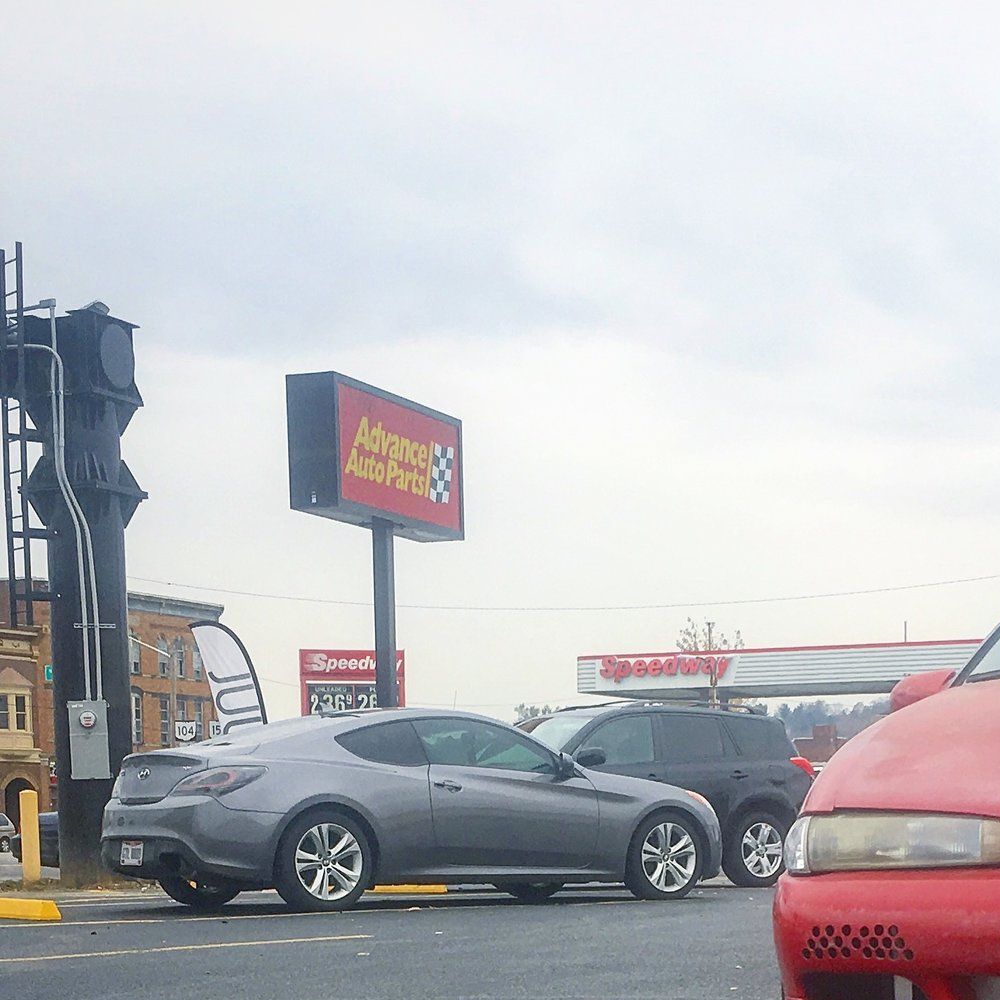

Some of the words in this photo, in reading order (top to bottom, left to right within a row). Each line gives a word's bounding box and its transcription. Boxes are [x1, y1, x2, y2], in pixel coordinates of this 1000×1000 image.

[353, 416, 428, 469] Advance
[345, 447, 385, 484] Auto
[386, 458, 426, 496] Parts
[600, 656, 731, 683] Speedway
[177, 725, 194, 736] 104
